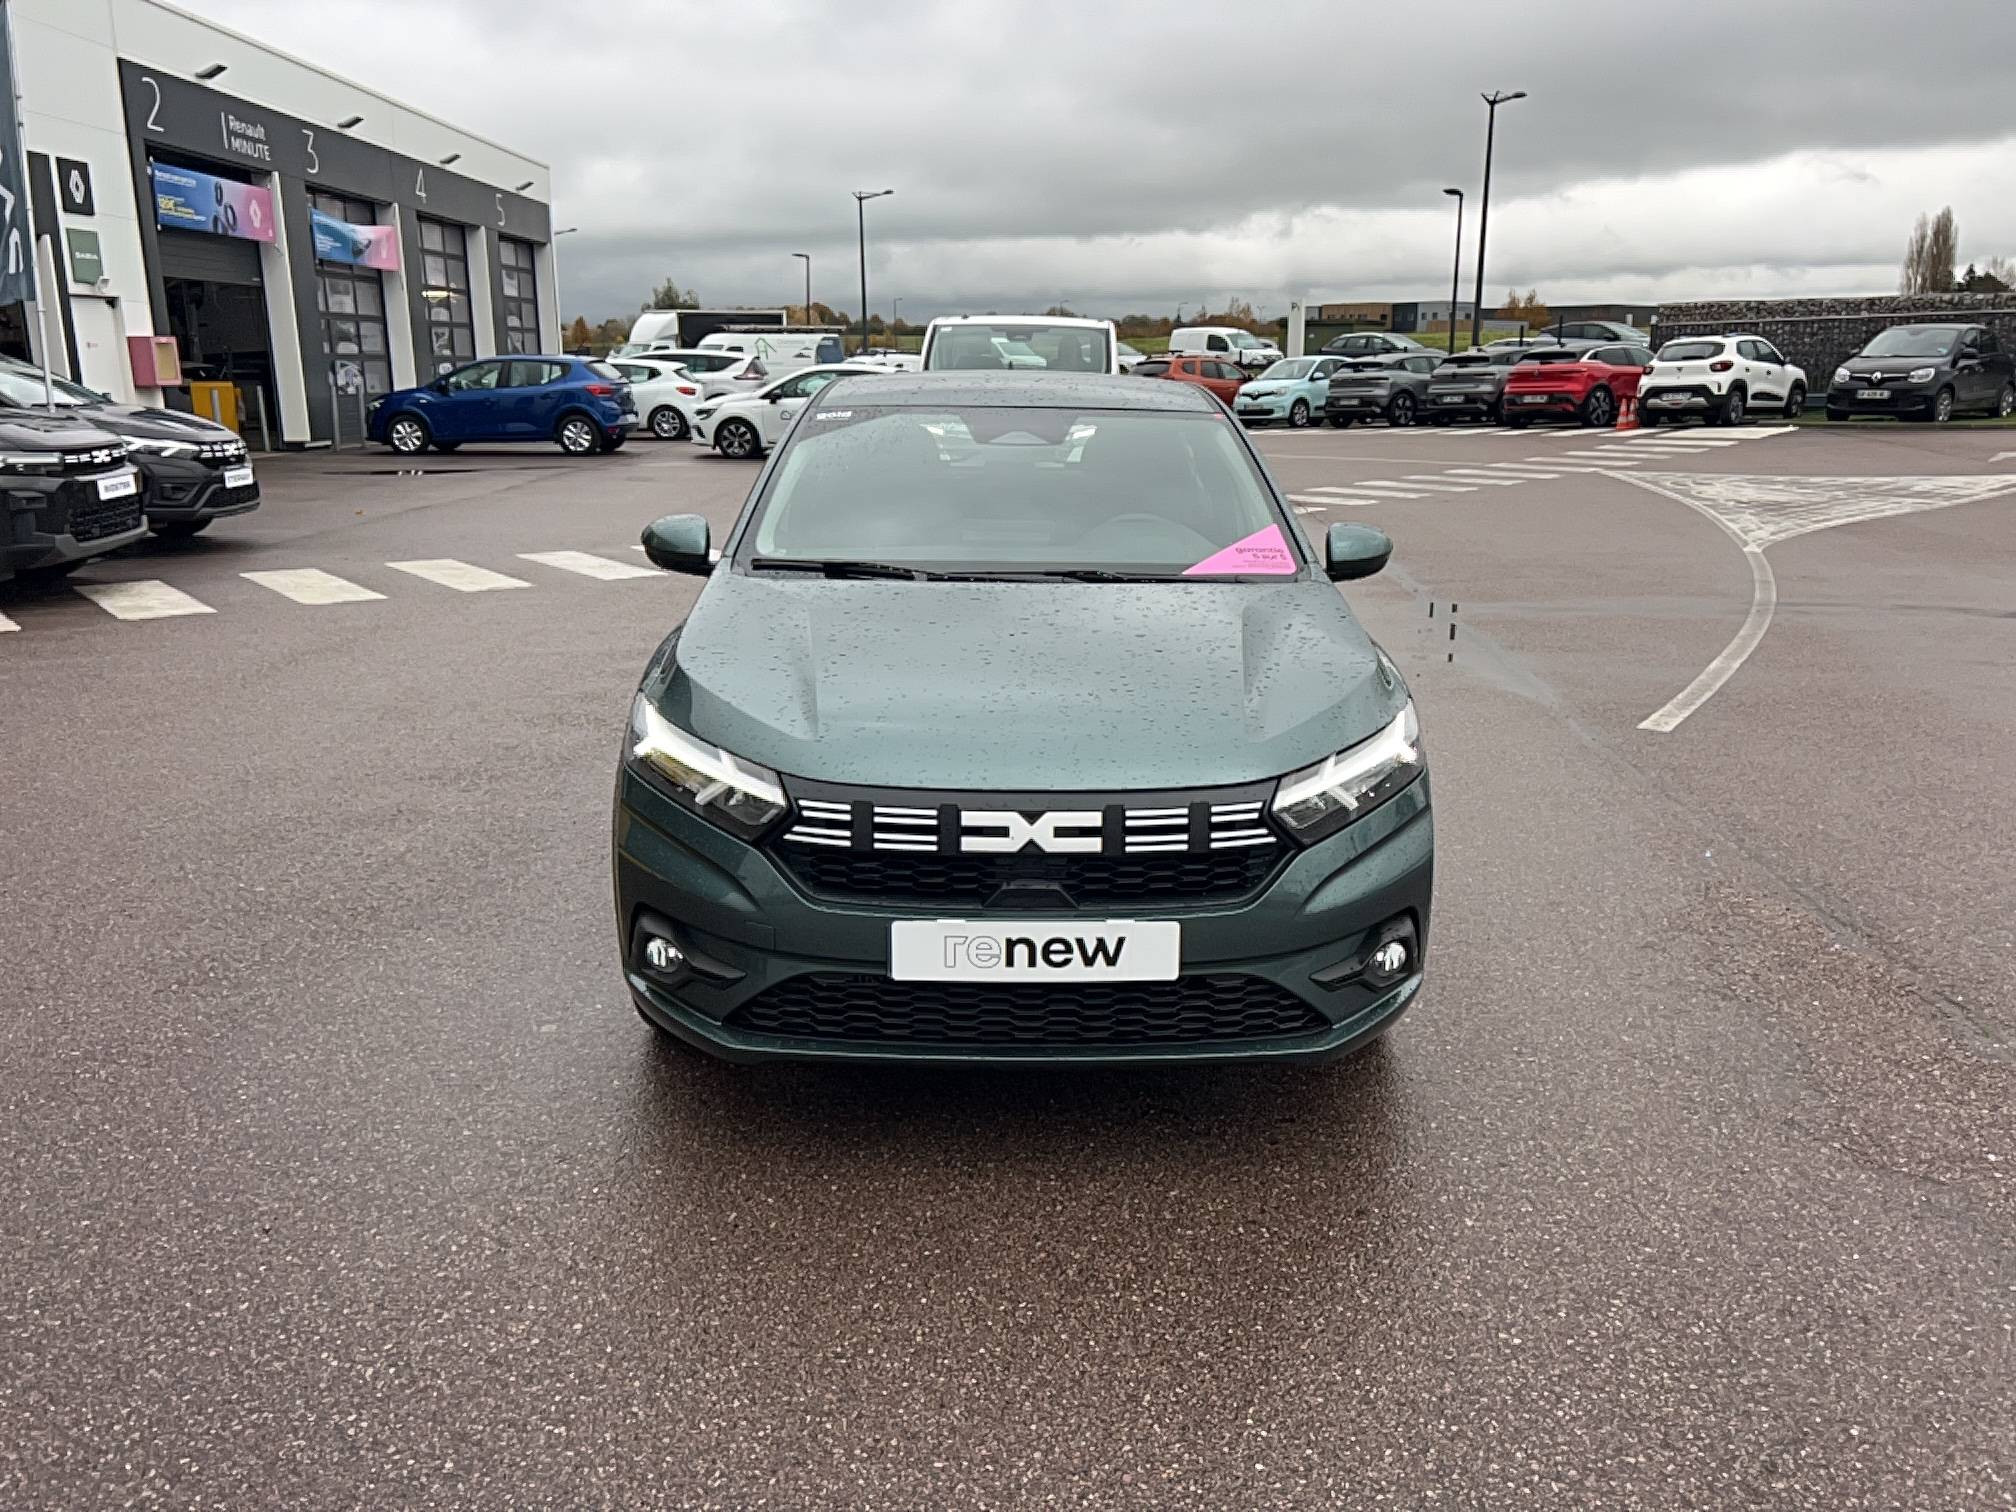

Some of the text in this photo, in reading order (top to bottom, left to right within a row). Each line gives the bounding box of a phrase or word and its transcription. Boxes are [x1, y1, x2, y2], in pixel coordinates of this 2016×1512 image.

[141, 76, 165, 132] 2
[228, 114, 267, 141] Renault
[231, 136, 272, 161] MINUTE
[301, 128, 319, 174] 3
[415, 168, 427, 204] 4
[495, 193, 505, 226] 5
[943, 934, 1127, 968] renew
